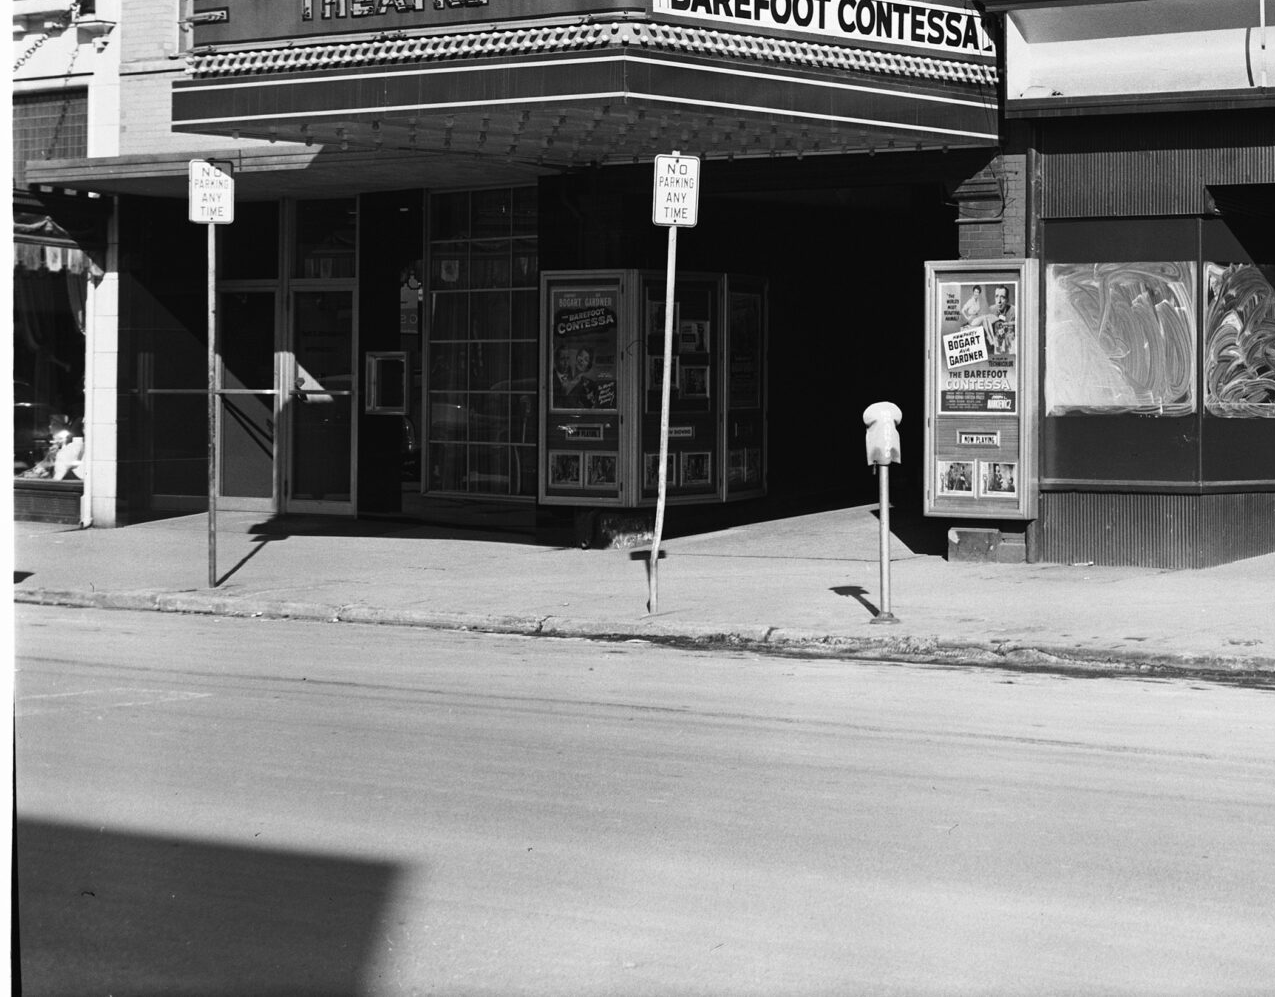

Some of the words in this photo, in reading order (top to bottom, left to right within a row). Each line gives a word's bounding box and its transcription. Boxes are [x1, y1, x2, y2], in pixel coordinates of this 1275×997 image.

[202, 167, 222, 178] NO
[667, 164, 688, 175] NO
[194, 178, 229, 189] PARKING
[659, 176, 694, 189] PARKING
[202, 193, 222, 202] ANY
[666, 192, 687, 203] ANY
[200, 206, 224, 217] TIME
[664, 206, 688, 219] TIME
[557, 314, 614, 335] CONTESSA
[948, 335, 980, 351] BOGART
[949, 350, 984, 366] GARDNER
[949, 371, 962, 379] THE
[964, 370, 1008, 379] BAREFOOT
[946, 379, 1011, 390] CONTESSA
